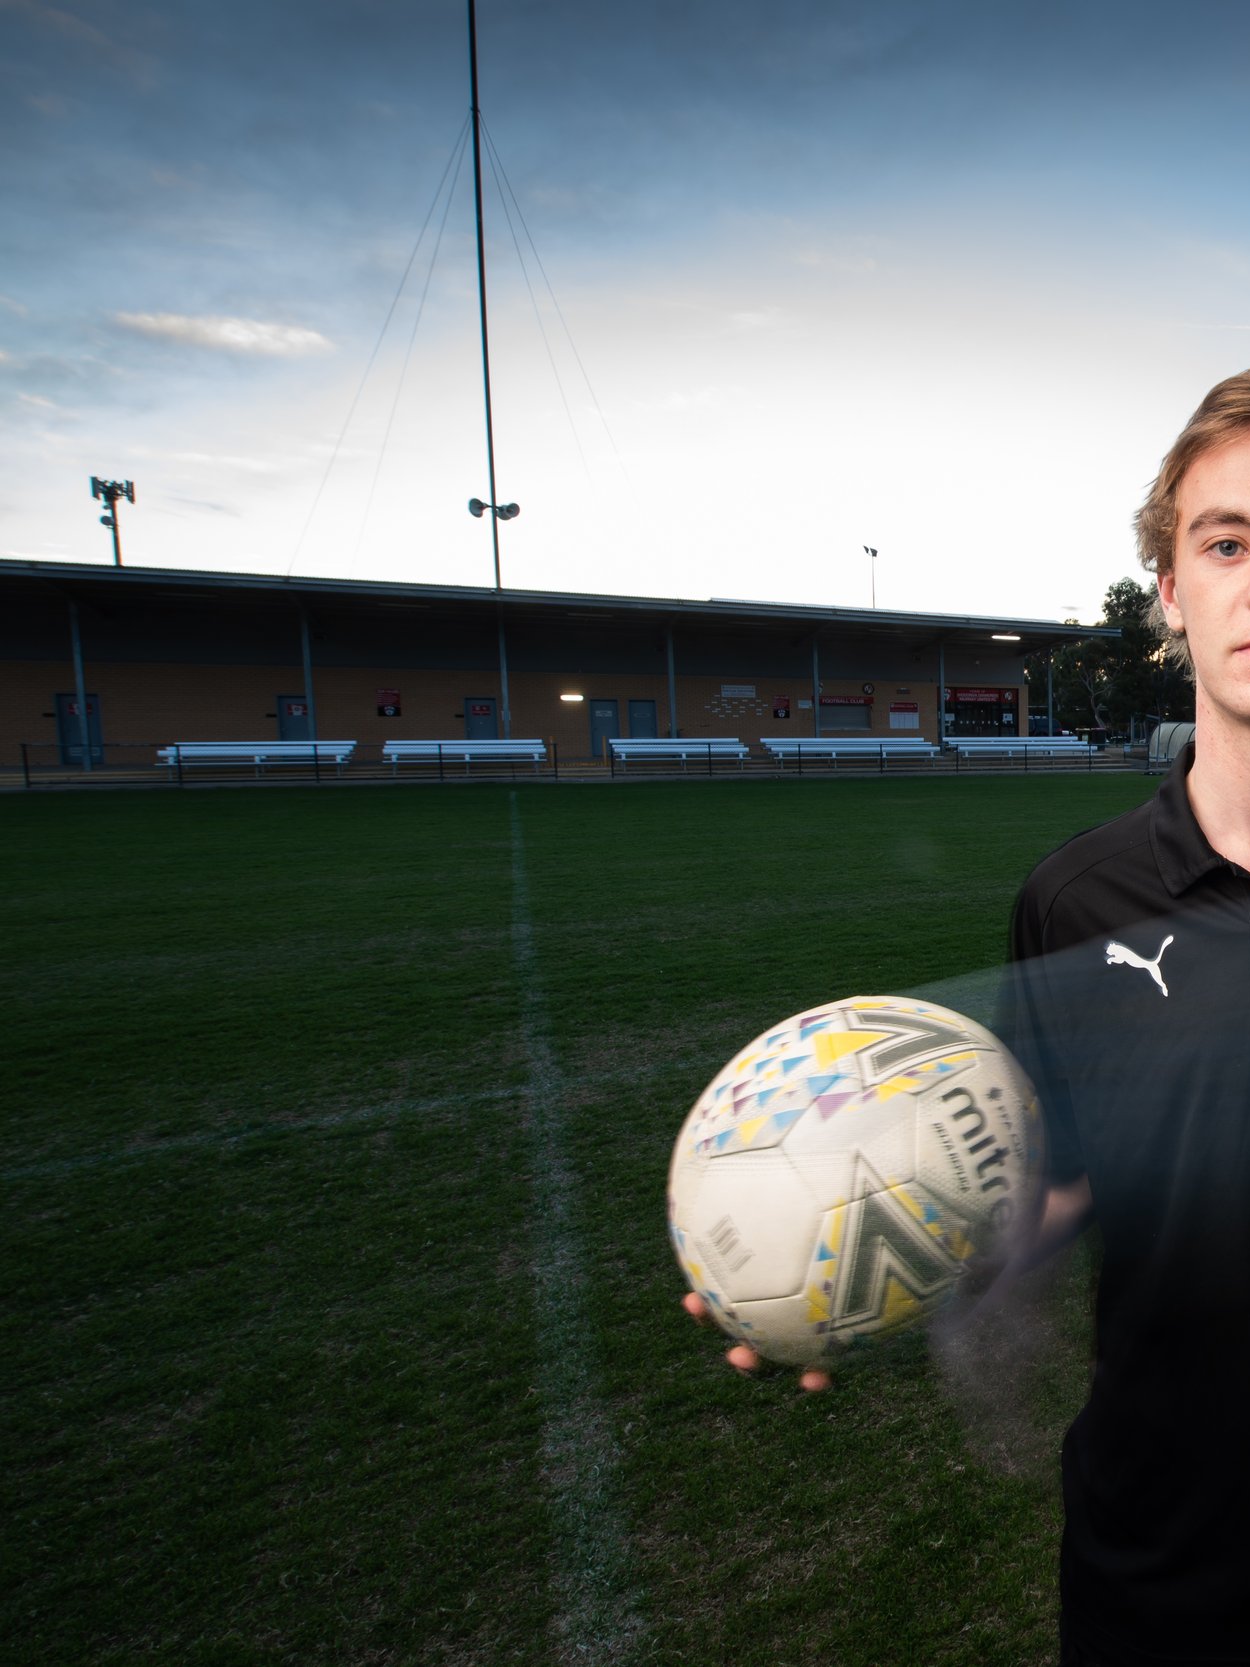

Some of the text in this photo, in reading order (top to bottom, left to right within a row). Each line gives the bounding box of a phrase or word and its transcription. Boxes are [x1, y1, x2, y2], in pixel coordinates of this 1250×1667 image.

[932, 1122, 971, 1194] DELTA REPLICA
[941, 1086, 1015, 1224] mitre
